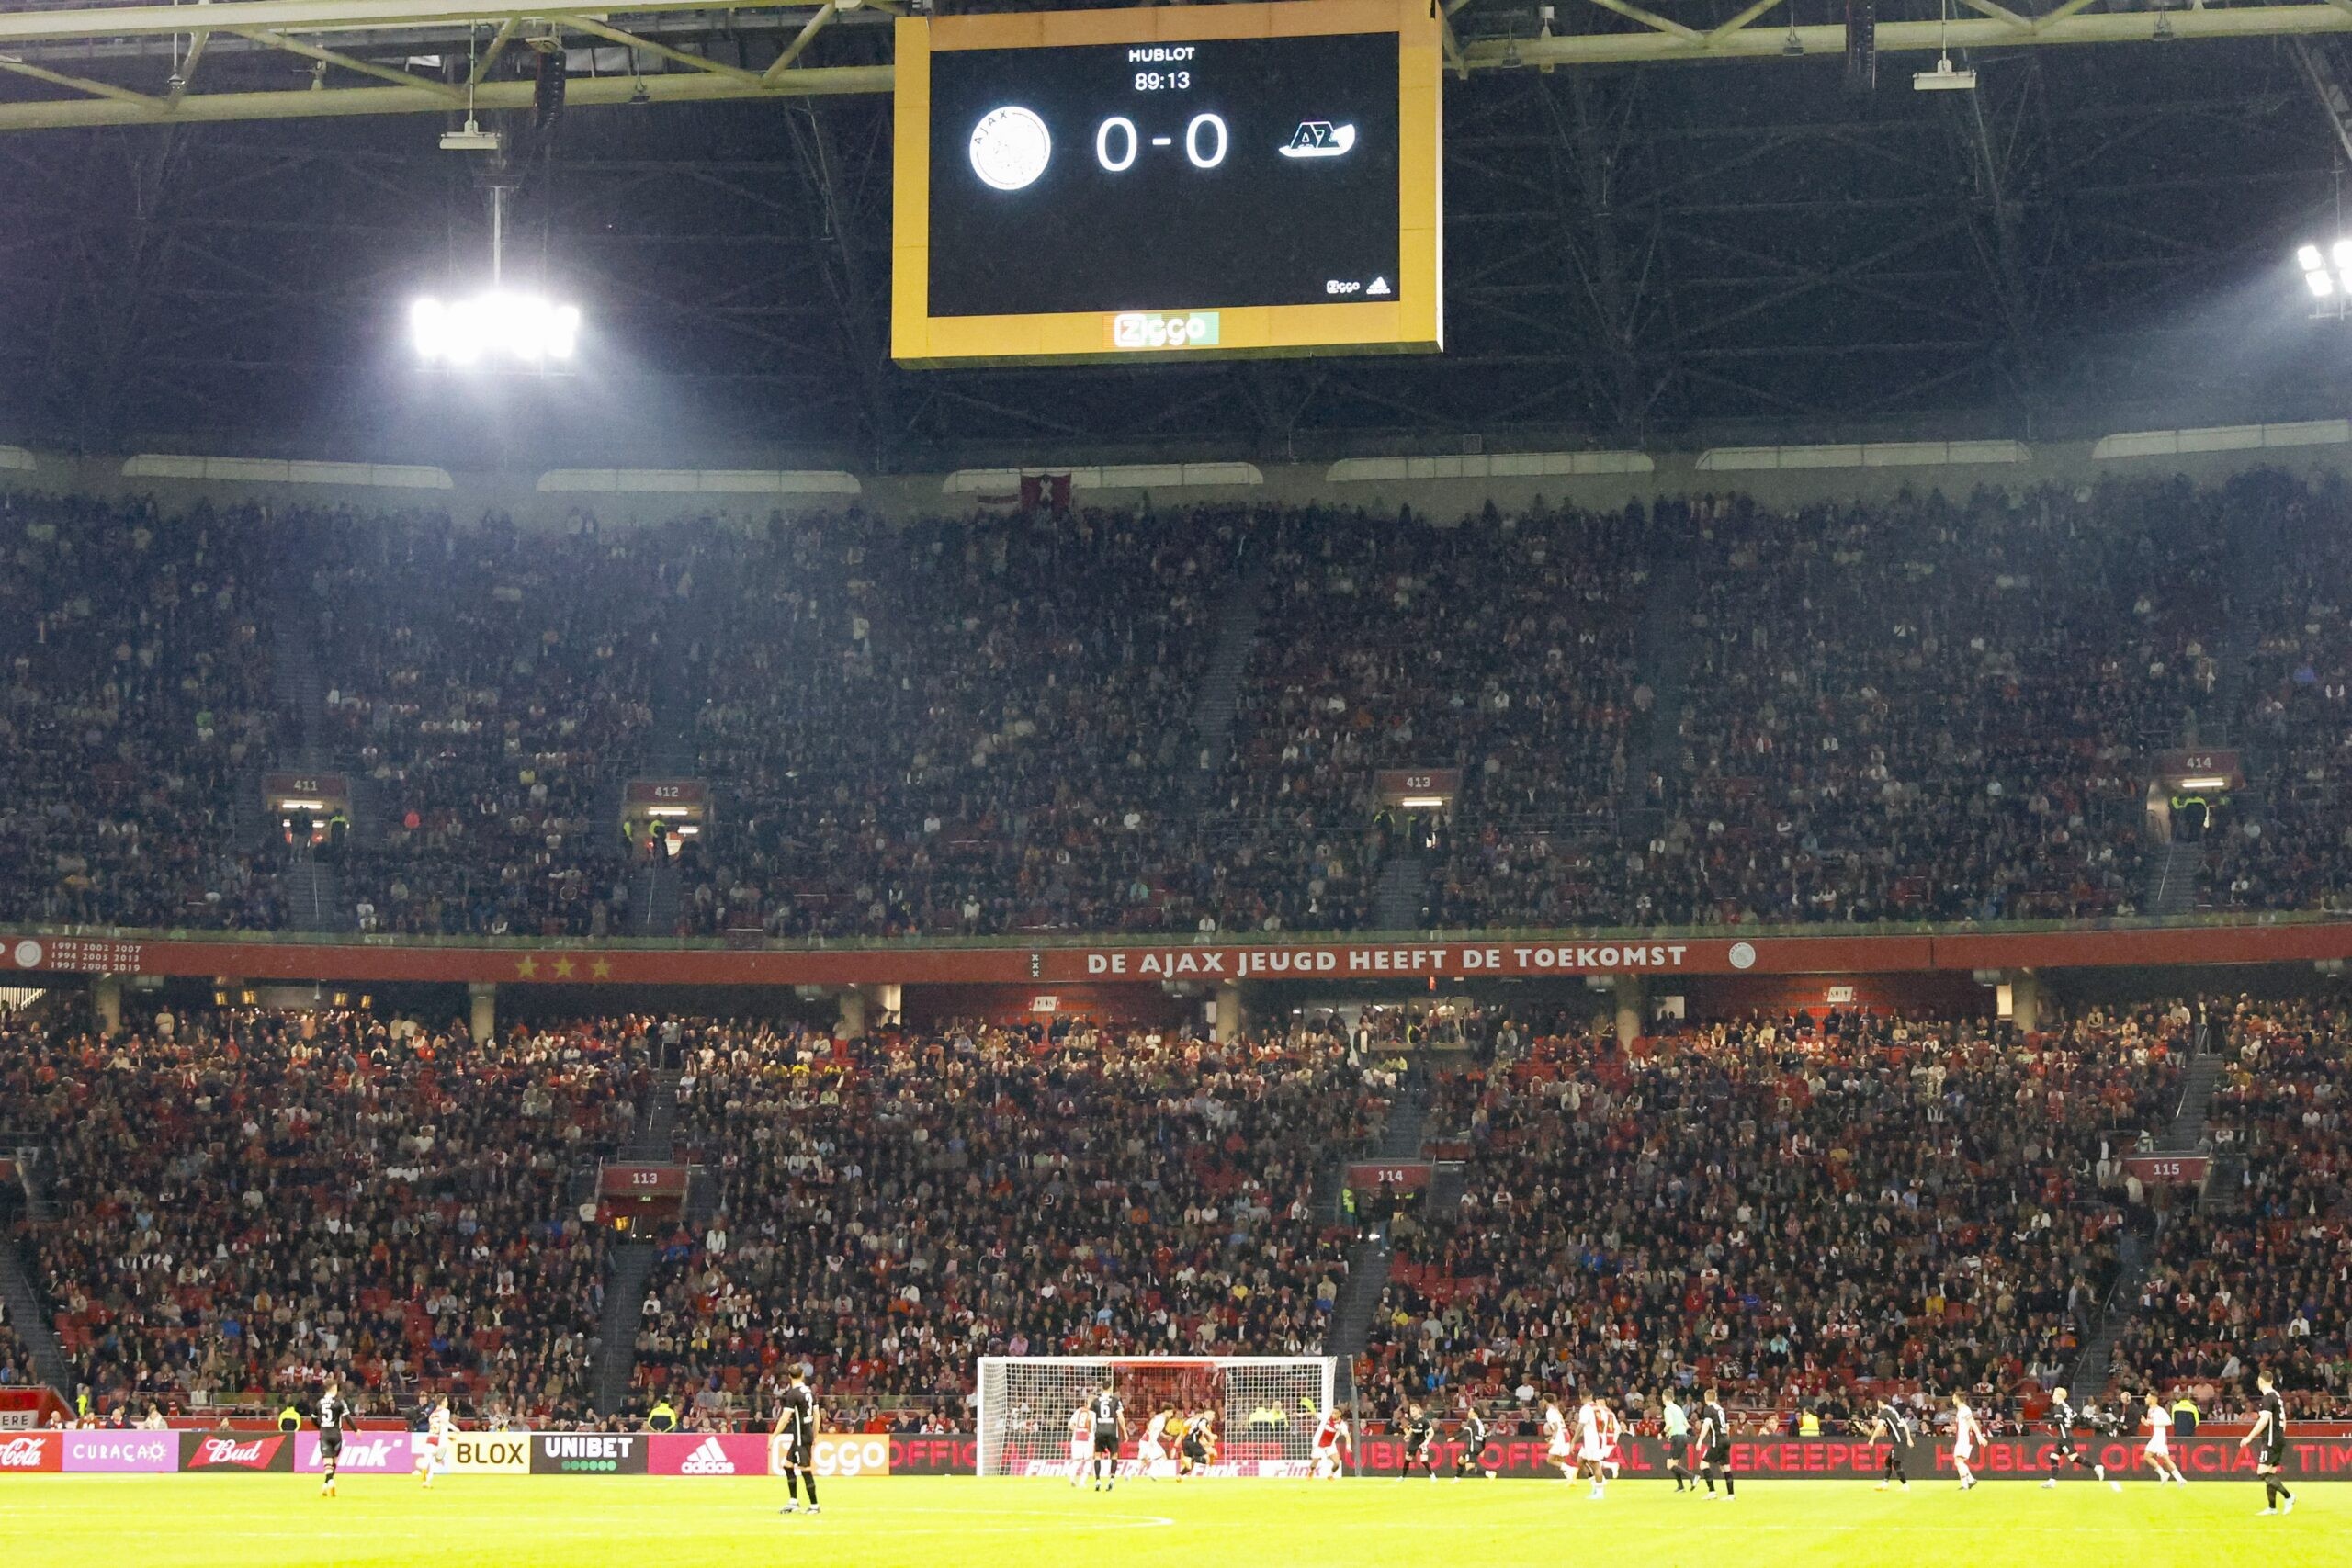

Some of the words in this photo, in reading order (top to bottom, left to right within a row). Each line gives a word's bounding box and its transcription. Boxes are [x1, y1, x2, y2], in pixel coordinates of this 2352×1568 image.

[1128, 47, 1195, 62] HUBLOT
[1135, 71, 1191, 91] 89:13
[974, 109, 1009, 145] AJAX
[1289, 121, 1342, 151] AZ
[1114, 312, 1206, 348] Ziggo
[2187, 757, 2211, 768] 414
[294, 780, 318, 791] 411
[654, 786, 679, 797] 412
[1406, 777, 1430, 787] 413
[82, 953, 108, 961] 2005
[83, 943, 109, 952] 2002
[1088, 953, 1126, 973] DE
[1139, 953, 1225, 977] AJAX
[1237, 951, 1337, 976] JEUGD
[1349, 950, 1447, 970] HEEFT
[1463, 949, 1501, 968] DE
[1514, 946, 1687, 967] TOEKOMST
[632, 1173, 658, 1184] 113
[1378, 1170, 1403, 1181] 114
[2154, 1163, 2180, 1175] 115
[322, 1404, 333, 1423] 5
[1100, 1400, 1111, 1418] 6
[74, 1442, 164, 1462] CURAÇAO
[206, 1439, 263, 1462] Bud
[309, 1438, 391, 1467] Fink
[458, 1443, 524, 1464] BLOX
[545, 1437, 633, 1458] UNIBET
[772, 1434, 885, 1476] ggo
[1343, 1442, 1469, 1470] UBLOT
[1477, 1443, 1651, 1471] OFFAL
[1662, 1442, 1894, 1472] IEKEEPE
[2101, 1443, 2284, 1472] OFICIA
[681, 1459, 734, 1474] adidas
